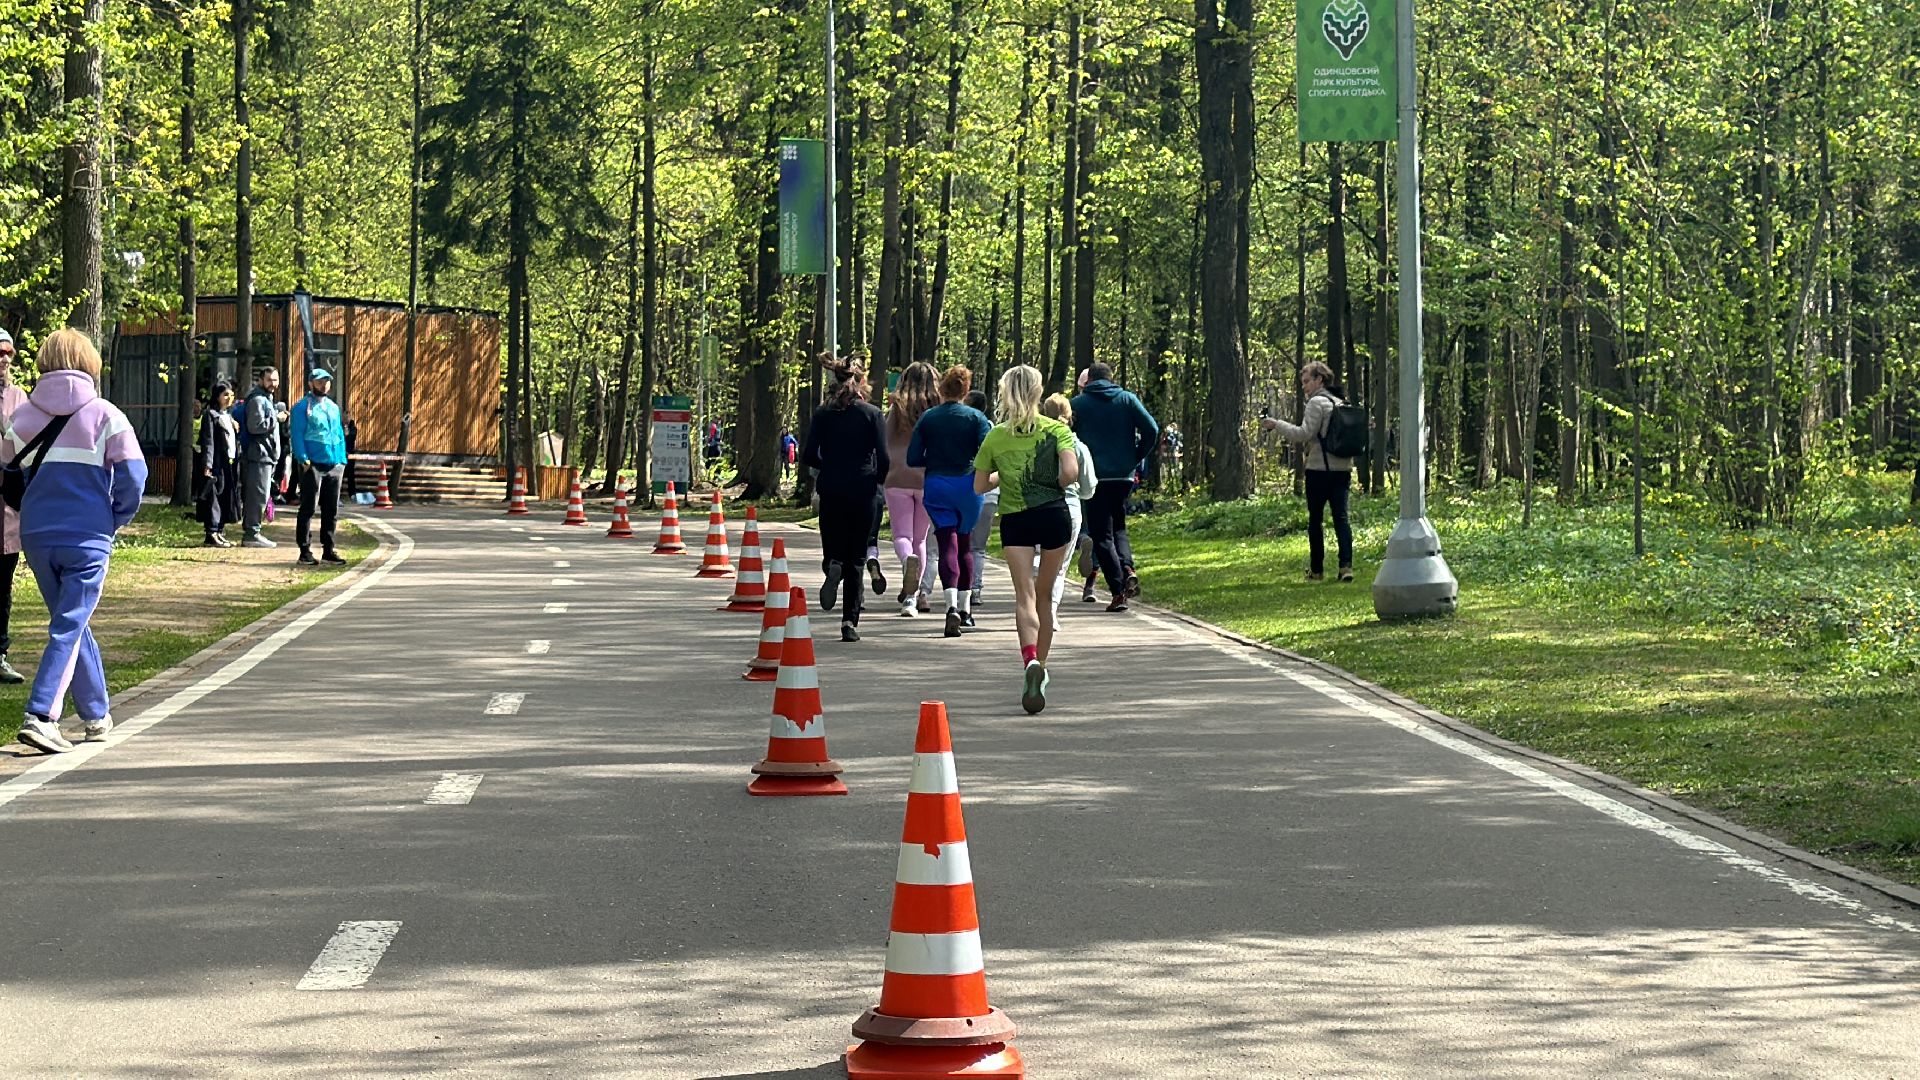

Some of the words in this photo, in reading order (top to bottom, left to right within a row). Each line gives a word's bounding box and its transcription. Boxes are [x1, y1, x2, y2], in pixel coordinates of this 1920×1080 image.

[1314, 66, 1380, 76] ОДИНЦОВСКИЙ
[1313, 78, 1334, 86] ПАРК
[1308, 89, 1342, 97] СПОРТА
[1343, 89, 1349, 97] И
[1350, 88, 1386, 97] ОТДЫХА
